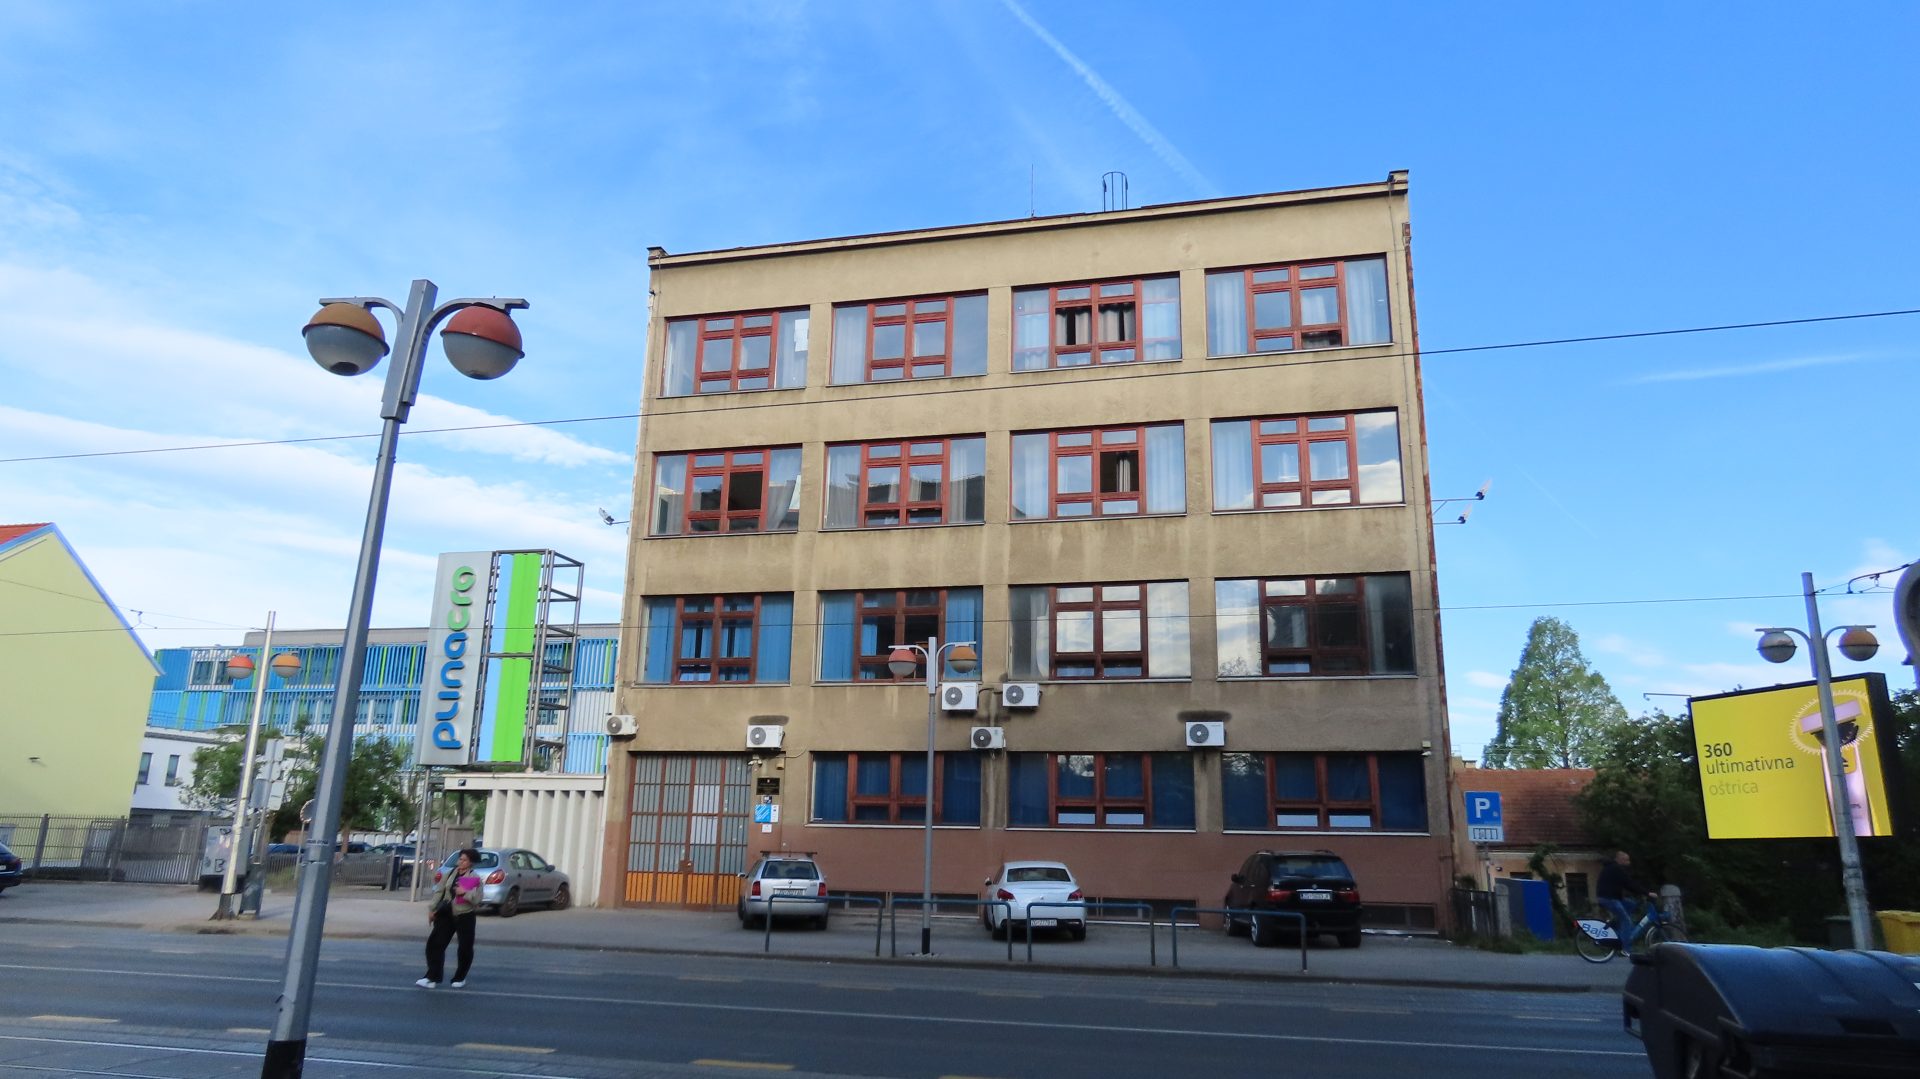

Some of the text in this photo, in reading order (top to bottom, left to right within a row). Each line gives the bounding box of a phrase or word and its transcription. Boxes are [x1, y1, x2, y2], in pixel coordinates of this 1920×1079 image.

[432, 565, 476, 750] plinacro
[1704, 742, 1732, 759] 360
[1706, 756, 1795, 775] ultimativna
[1708, 779, 1758, 796] oštrica
[1474, 797, 1490, 819] P
[1582, 923, 1609, 938] Bajs
